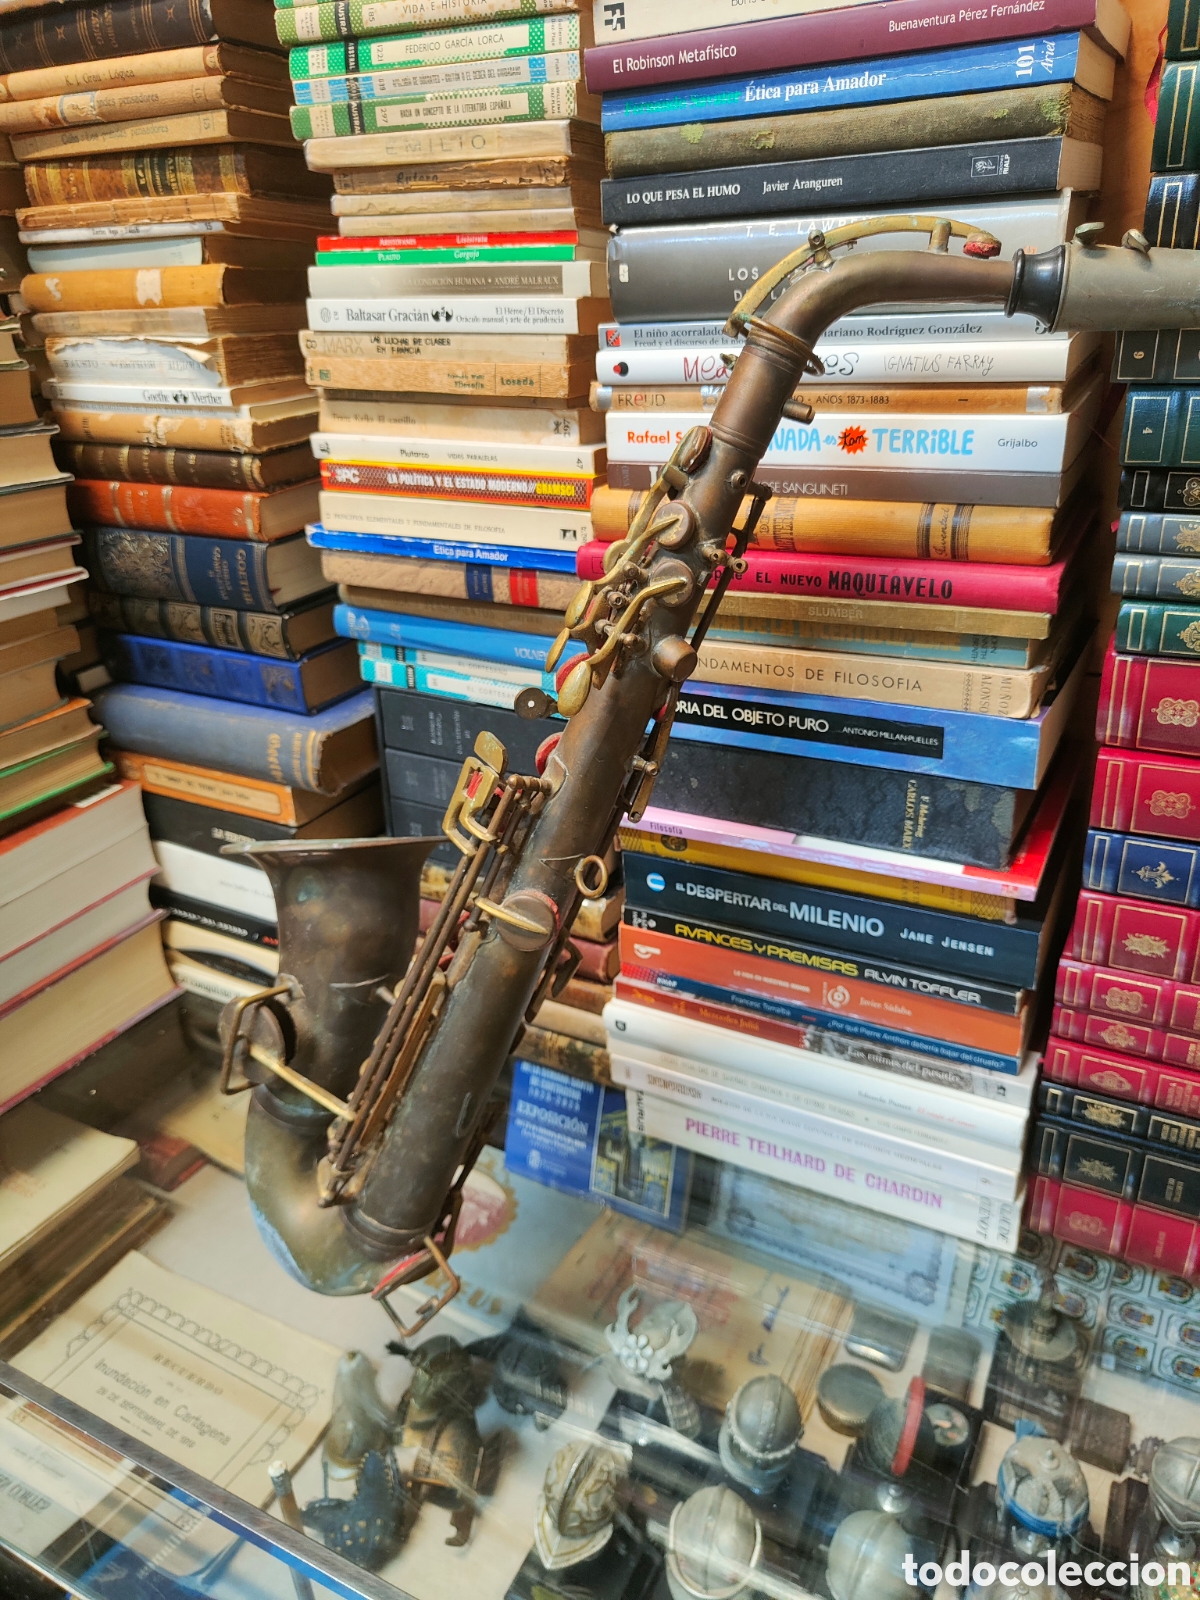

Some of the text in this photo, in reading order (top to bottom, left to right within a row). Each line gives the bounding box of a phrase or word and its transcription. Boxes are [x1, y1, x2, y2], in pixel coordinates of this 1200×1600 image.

[402, 2, 426, 14] VIDA
[430, 2, 436, 10] E
[888, 0, 1046, 32] Buenaventura Pérez Fernández
[405, 34, 505, 54] FEDERICO GARCÍA LORCA
[612, 44, 737, 73] El Robinson Metafísico
[1016, 44, 1036, 78] 101
[1040, 40, 1056, 74] Ariel
[109, 68, 135, 80] Lógica
[744, 70, 887, 104] Ética para Amador
[423, 100, 512, 116] CONCEPTO DE LA LITERATURA ESPAÑOLA
[350, 102, 360, 134] AUSTRAL
[131, 124, 169, 137] pensadores
[1003, 154, 1011, 174] RIALP
[626, 176, 843, 204] LO QUE PESA EL HUMO Javier Aranguren
[746, 224, 780, 238] T. E.
[414, 274, 559, 287] CONDICIÓN HUMANA ANDRÉ MALRAUX
[728, 268, 759, 281] LOS
[346, 308, 386, 322] Baltasar
[388, 308, 430, 322] Gracián
[496, 307, 503, 315] El
[536, 308, 564, 316] Discreto
[523, 316, 564, 326] de prudencia
[634, 322, 982, 340] El niño acorralado Rodríguez González
[322, 337, 451, 355] MARX CLASES
[392, 346, 422, 356] FRANCIA
[634, 338, 729, 350] Freud y el discurso de la
[884, 354, 941, 374] IGNATIUS
[947, 356, 995, 376] FARRAY
[500, 376, 534, 387] Losada
[142, 390, 222, 405] Goethe Werther
[816, 392, 843, 404] AÑOS
[846, 394, 890, 406] 1873-1883
[378, 415, 416, 426] El castillo
[627, 430, 670, 444] Rafael
[997, 437, 1038, 449] Grijalbo
[400, 448, 430, 459] Plutarco
[466, 454, 498, 463] PARALELAS
[387, 472, 398, 484] LA
[400, 474, 434, 488] POLÍTICA
[436, 476, 442, 488] Y
[444, 476, 454, 488] EL
[456, 478, 486, 491] ESTADO
[782, 482, 848, 496] SANGUINETI
[366, 514, 404, 526] ELEMENTALES
[413, 518, 462, 531] FUNDAMENTALES
[456, 548, 508, 562] para Amador
[756, 570, 954, 600] EL NUEVO MAQUIAVELO
[807, 606, 864, 620] SLUMBER
[468, 663, 508, 676] CORTESANO
[804, 668, 923, 693] DE FILOSOFIA
[978, 672, 989, 714] ALONSO
[997, 675, 1013, 717] MUÑOZ
[702, 702, 879, 738] DEL OBJETO PURO ANTONIO
[902, 778, 918, 849] CARLOS MARX
[676, 882, 995, 958] EL DESPERTAR DEL MILENIO JANE JENSEN
[675, 923, 982, 1004] AVANCES Y PREMISAS ALVIN TOFFLER
[859, 997, 912, 1017] Javier Sádaba
[731, 994, 761, 1010] Francesc
[762, 1001, 792, 1018] Torralba
[828, 1019, 844, 1031] ¿Por
[859, 1026, 881, 1039] Pierre
[960, 1052, 972, 1061] del
[848, 1046, 866, 1060] Las
[902, 1058, 918, 1073] del
[636, 1090, 646, 1132] TAURUS
[684, 1116, 944, 1210] PIERRE TEILHARD DE CHARDIN
[94, 1358, 232, 1447] Inundación en Cartagena
[120, 1397, 166, 1434] SEPTIEMBRE
